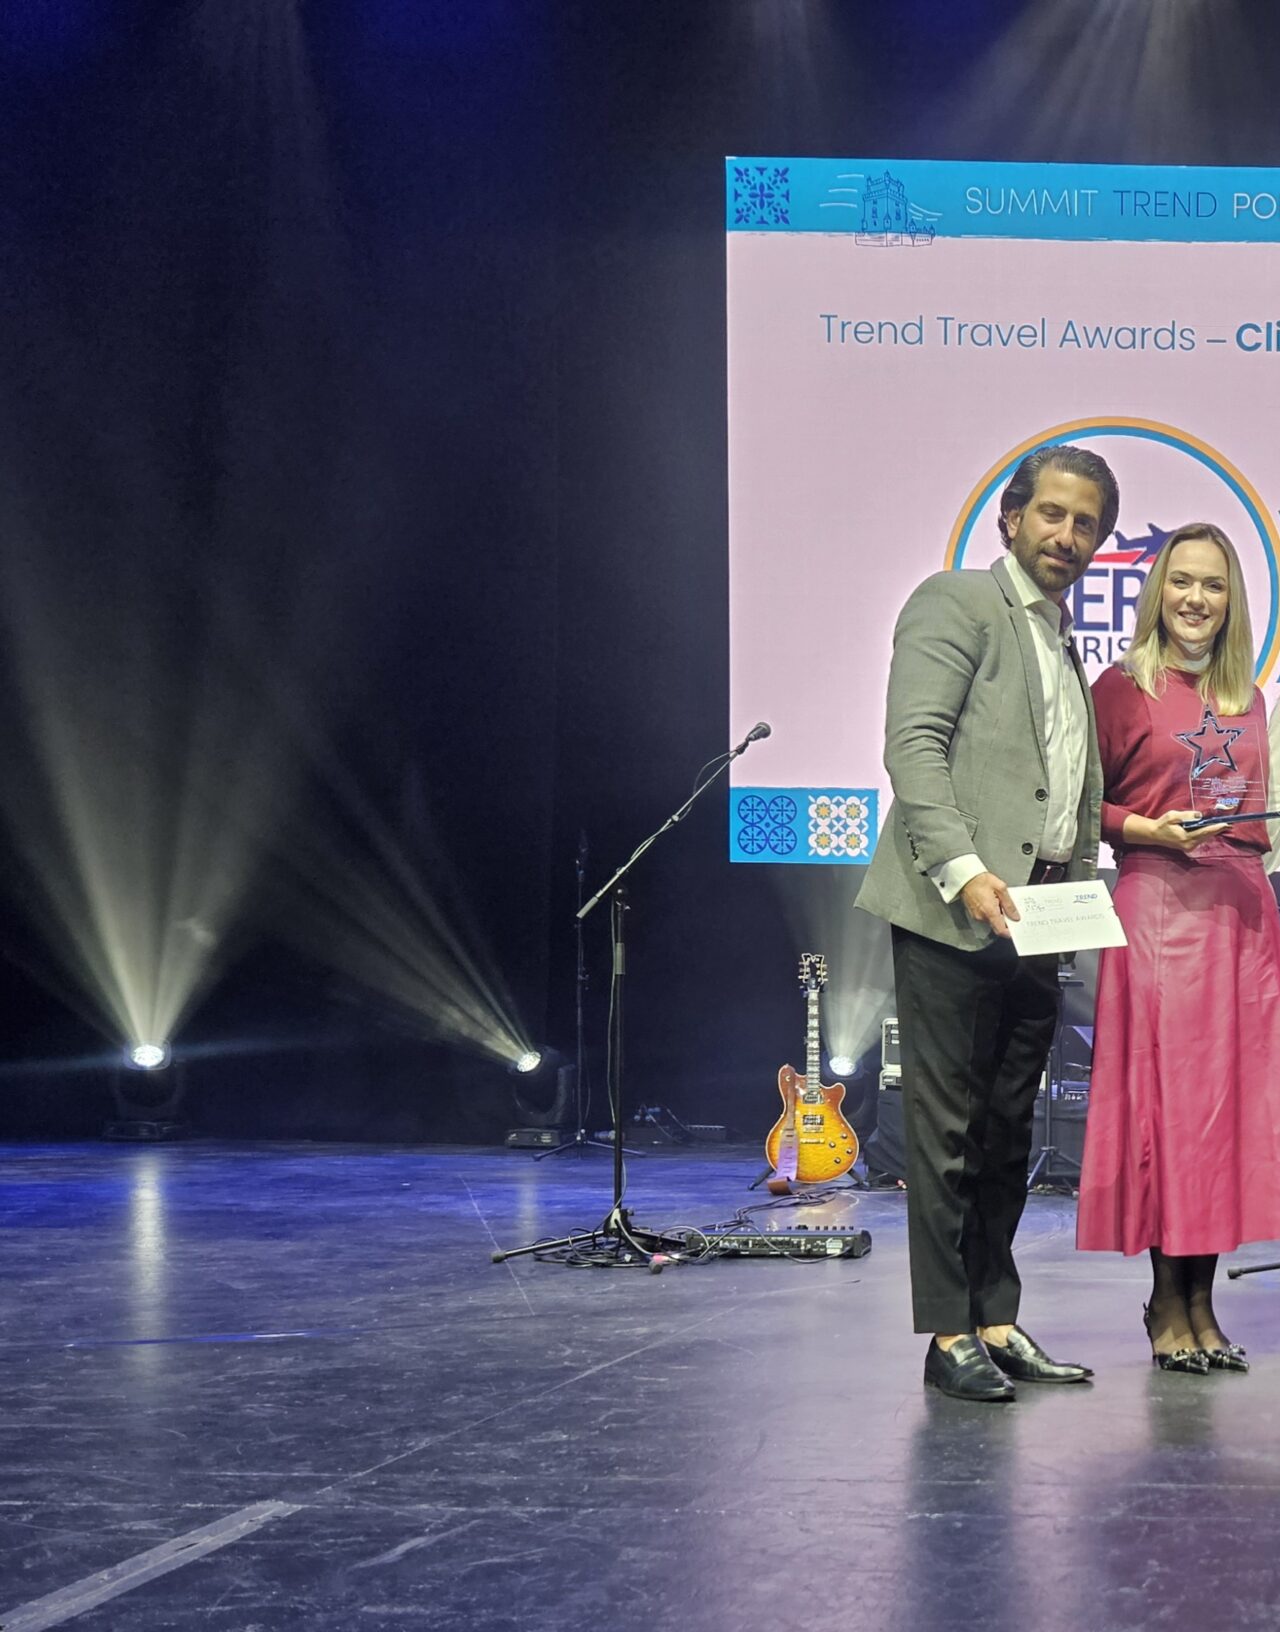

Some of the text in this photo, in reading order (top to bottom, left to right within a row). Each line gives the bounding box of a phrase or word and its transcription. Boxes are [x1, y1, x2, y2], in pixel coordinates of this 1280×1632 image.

[965, 186, 1099, 216] SUMMIT
[1113, 190, 1218, 218] TREND
[819, 314, 924, 345] Trend
[937, 316, 1046, 348] Travel
[1058, 320, 1196, 351] Awards
[1063, 568, 1148, 632] ER
